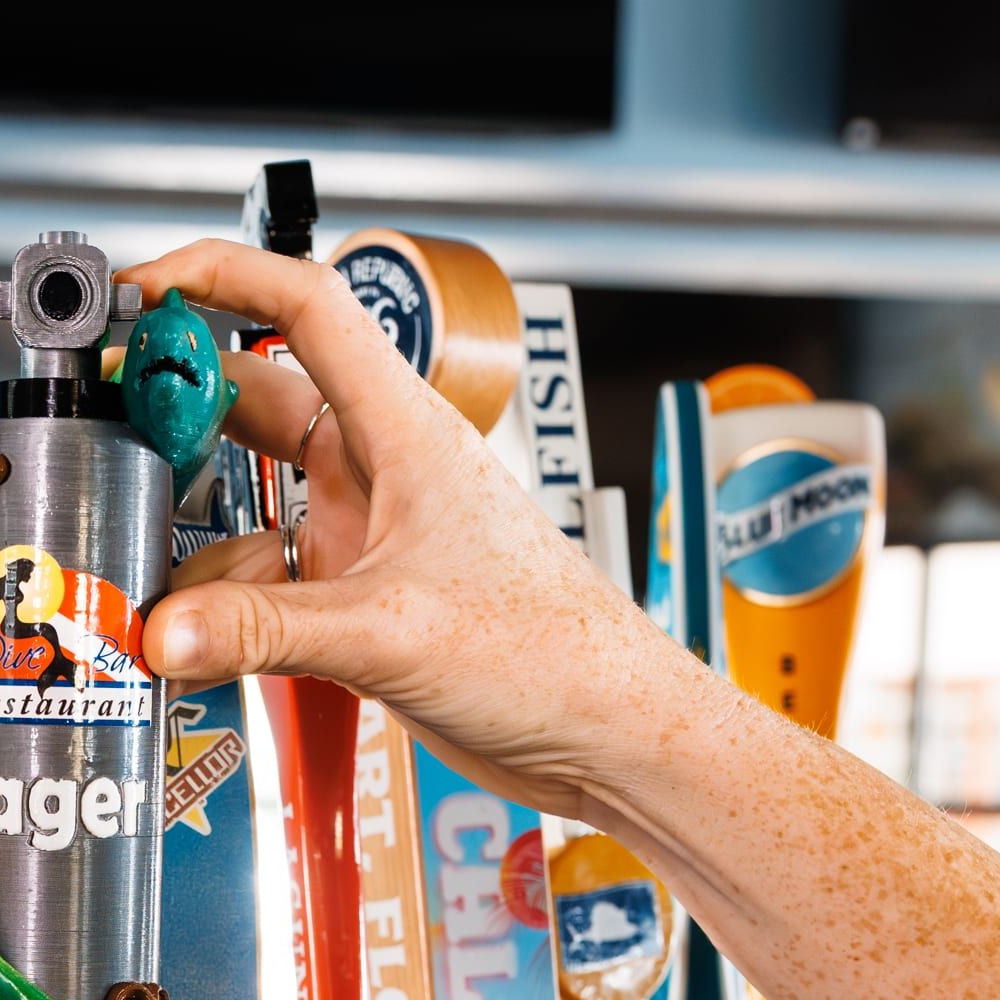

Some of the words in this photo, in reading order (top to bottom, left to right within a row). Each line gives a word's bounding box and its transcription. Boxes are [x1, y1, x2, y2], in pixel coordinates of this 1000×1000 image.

[82, 632, 144, 674] Bar
[165, 738, 243, 819] CELLOR
[358, 696, 397, 873] ART,
